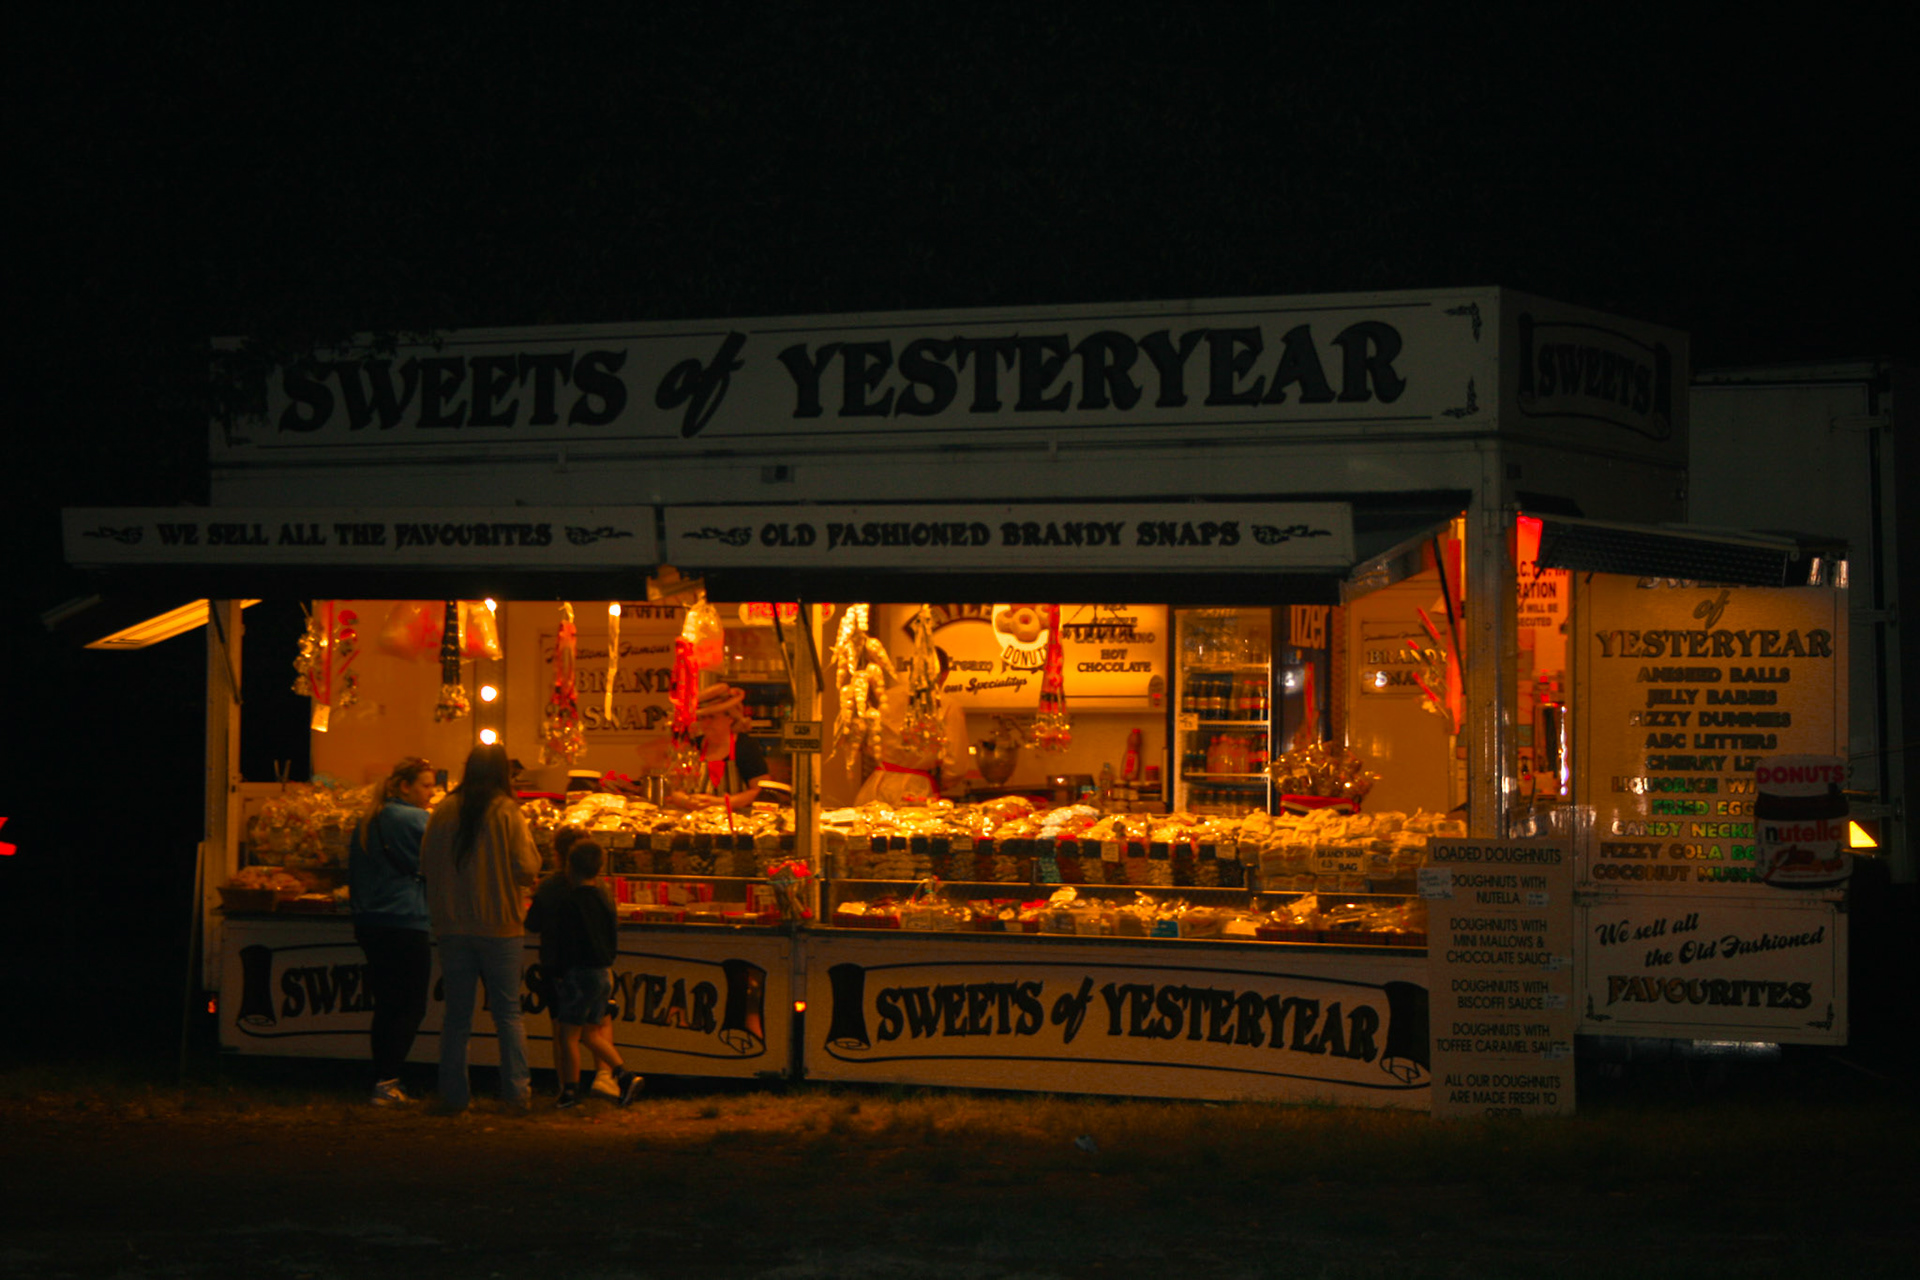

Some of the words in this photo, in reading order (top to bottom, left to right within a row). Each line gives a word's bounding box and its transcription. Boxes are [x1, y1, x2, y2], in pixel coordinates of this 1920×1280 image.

[278, 350, 627, 433] SWEETS
[655, 331, 744, 438] of
[777, 321, 1405, 418] YESTERYEAR
[1538, 343, 1651, 415] SWEETS
[156, 523, 197, 545] WE
[207, 523, 268, 545] SELL
[278, 523, 326, 545] ALL
[334, 523, 386, 545] THE
[396, 523, 552, 550] FAVOURITES
[760, 523, 816, 547] OLD
[827, 521, 991, 550] FASHIONED
[1002, 521, 1122, 547] BRANDY
[1136, 520, 1240, 547] SNAPS
[1693, 589, 1730, 628] of
[1596, 629, 1832, 658] YESTERYEAR
[1100, 649, 1128, 660] HOT
[1077, 661, 1151, 672] CHOCOLATE
[1637, 667, 1722, 682] ANISEED
[1730, 667, 1790, 683] BALLS
[1646, 689, 1699, 707] JELLY
[1706, 689, 1777, 705] BABIES
[1698, 711, 1791, 727] DUMMIES
[1645, 734, 1686, 748] ABC
[1694, 734, 1777, 749] LETTERS
[1646, 755, 1727, 771] CHERRY
[1757, 766, 1844, 785] DONUTS
[1611, 776, 1718, 794] LIQUORICE
[1652, 799, 1710, 816] FRIED
[1611, 820, 1684, 838] CANDY
[1765, 818, 1842, 843] nutella
[1434, 846, 1481, 860] LOADED
[1485, 847, 1561, 863] DOUGHNUTS
[1669, 844, 1724, 860] COLA
[1592, 864, 1691, 881] COCONUT
[1451, 874, 1517, 888] DOUGHNUTS
[1521, 876, 1546, 889] WITH
[1476, 892, 1520, 904] NUTELLA
[1450, 918, 1517, 932] DOUGHNUTS
[1521, 919, 1547, 932] WITH
[1595, 920, 1628, 946] We
[1634, 919, 1665, 941] sell
[1672, 913, 1698, 934] all
[1453, 935, 1477, 947] MINI
[1479, 935, 1533, 948] MALLOWS
[1536, 936, 1545, 948] &
[1646, 948, 1673, 967] the
[1679, 940, 1717, 964] Old
[1720, 926, 1825, 957] Fashioned
[1447, 951, 1514, 964] CHOCOLATE
[1452, 979, 1519, 993] DOUGHNUTS
[1523, 981, 1548, 994] WITH
[1607, 975, 1812, 1010] FAVOURITES
[1508, 997, 1543, 1010] SAUCE
[876, 980, 1044, 1042] SWEETS
[1051, 976, 1093, 1044] of
[1101, 982, 1379, 1062] YESTERYEAR
[1453, 1023, 1520, 1036] DOUGHNUTS
[1524, 1024, 1549, 1037] WITH
[1437, 1039, 1471, 1052] TOFFEE
[1475, 1039, 1528, 1053] CARAMEL
[1445, 1074, 1463, 1087] ALL
[1469, 1074, 1490, 1087] OUR
[1493, 1075, 1561, 1089] DOUGHNUTS
[1450, 1090, 1470, 1103] ARE
[1473, 1091, 1505, 1104] MADE
[1509, 1092, 1540, 1104] FRESH
[1543, 1093, 1557, 1105] TO
